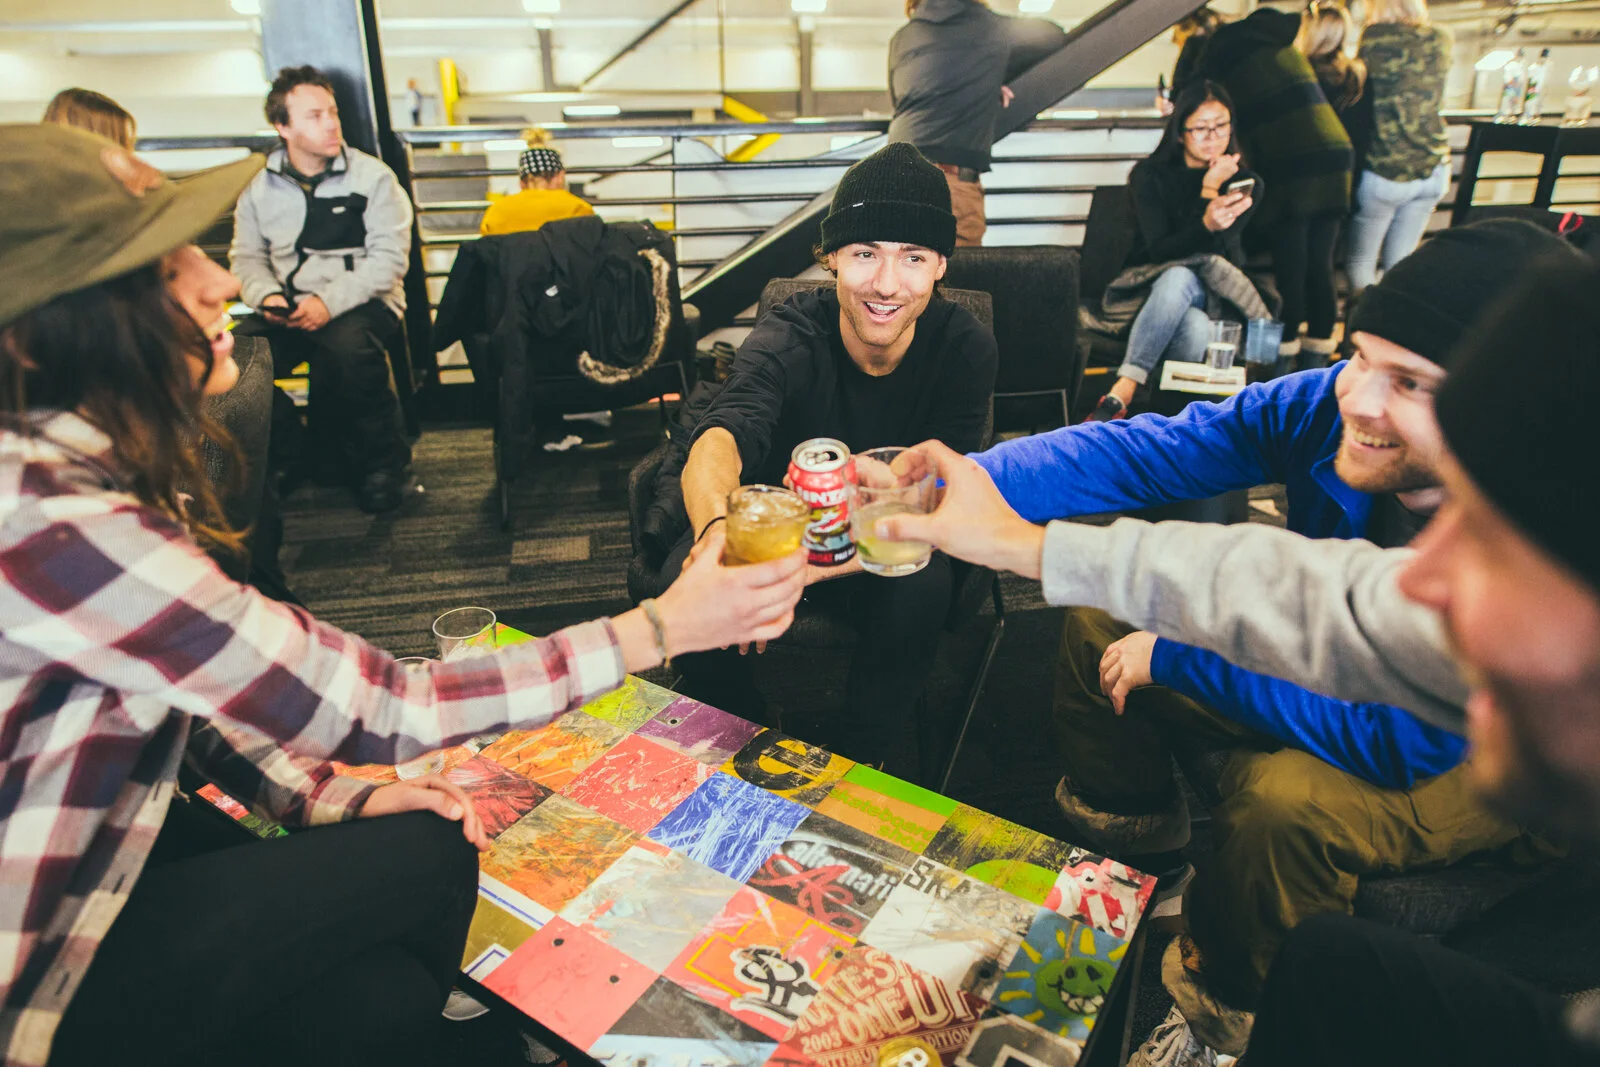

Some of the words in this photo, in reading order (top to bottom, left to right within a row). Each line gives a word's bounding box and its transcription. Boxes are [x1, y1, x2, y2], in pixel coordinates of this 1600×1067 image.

[877, 824, 926, 854] shop
[786, 840, 897, 900] altenati
[800, 1026, 843, 1054] 2003
[921, 1027, 972, 1048] DITION
